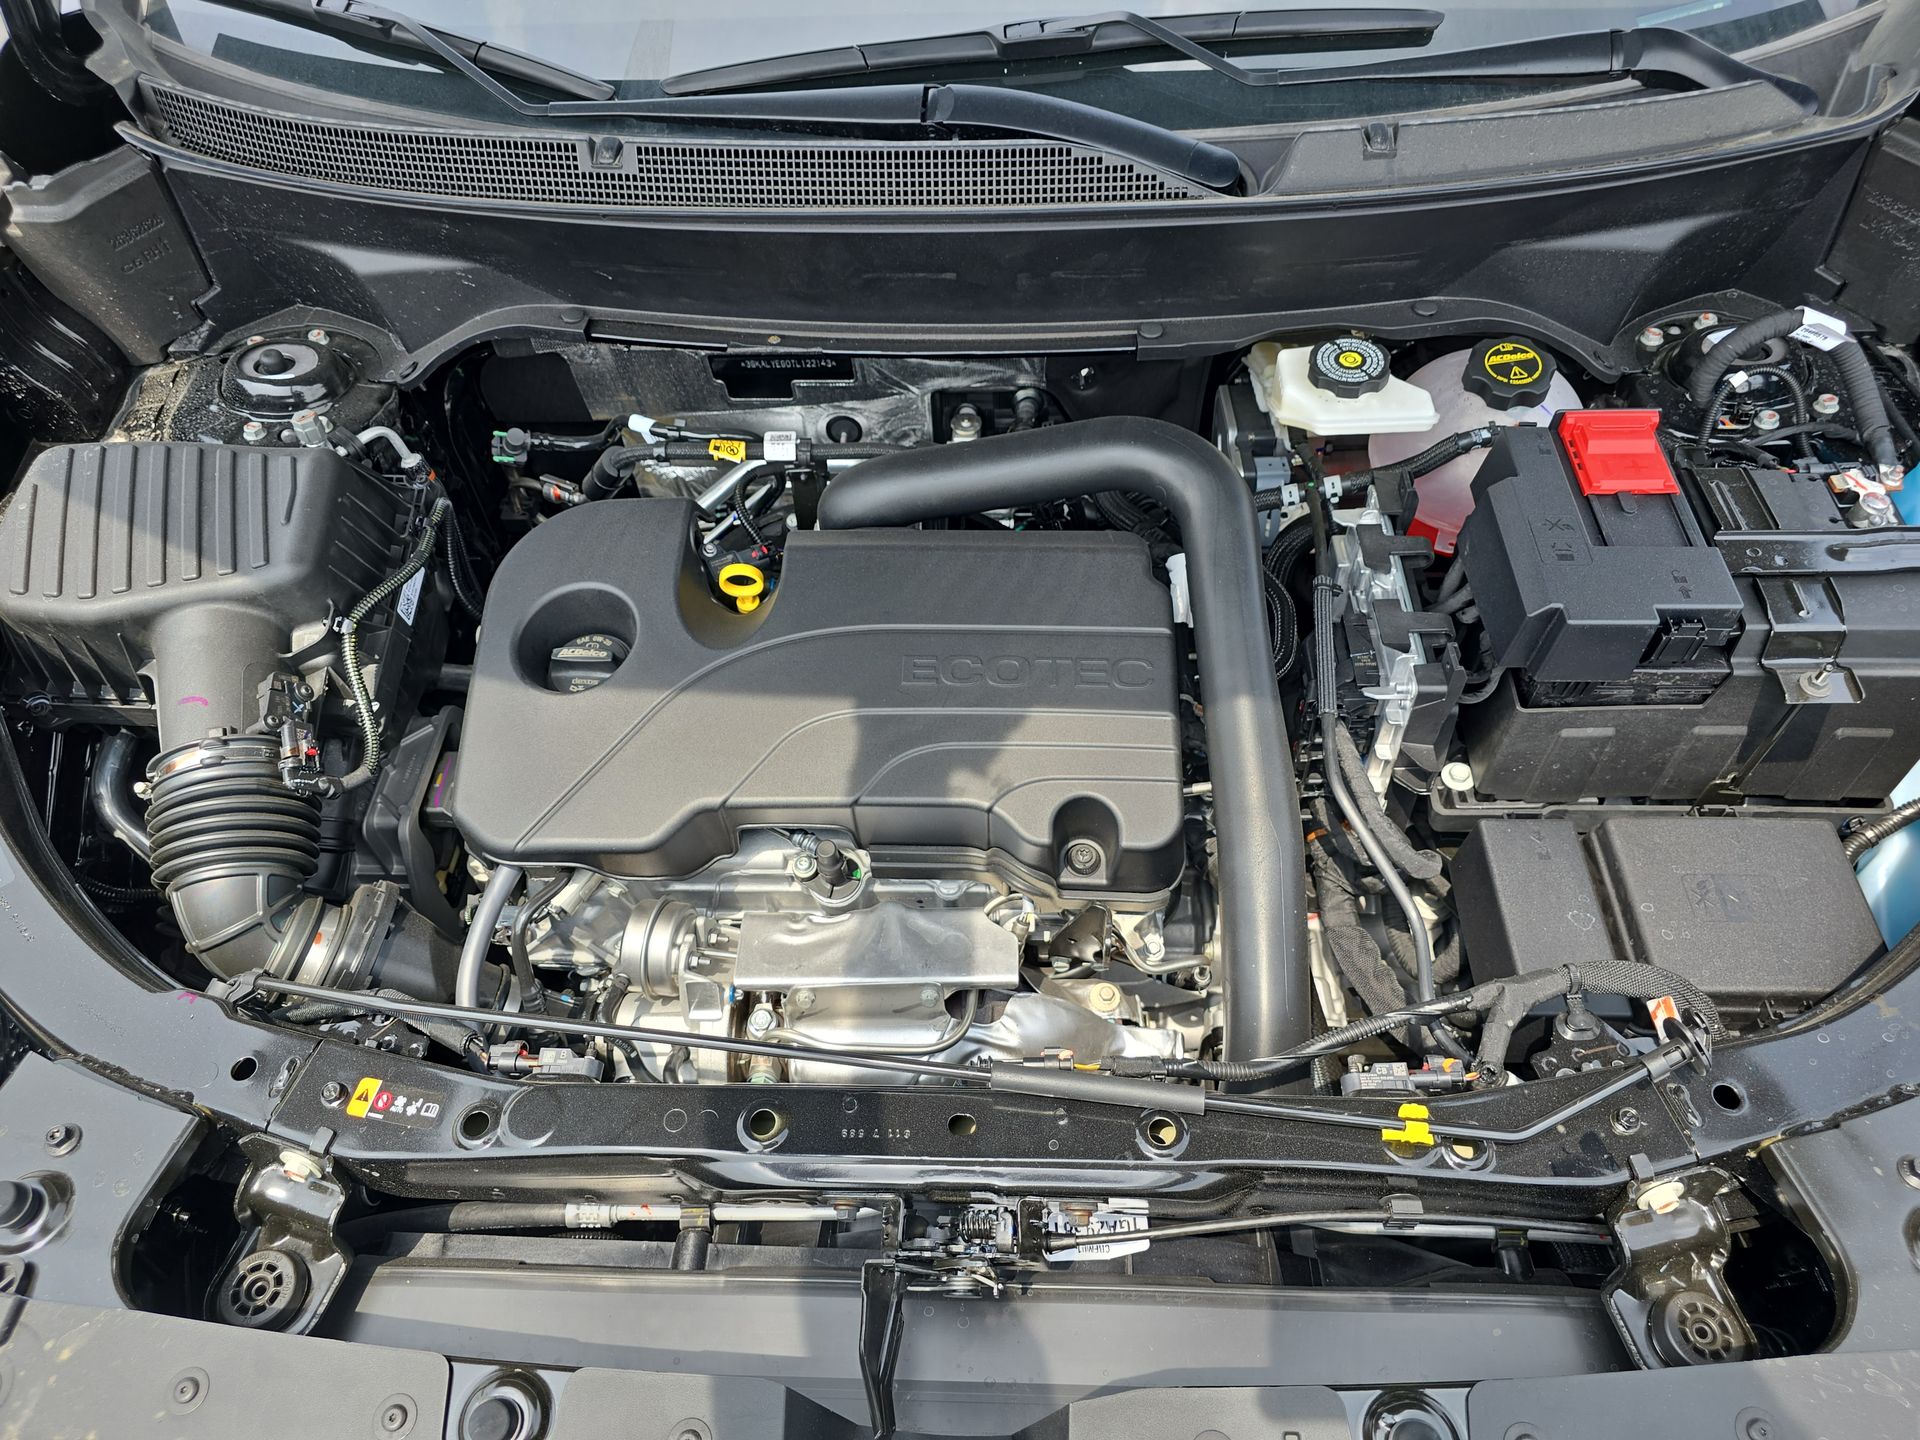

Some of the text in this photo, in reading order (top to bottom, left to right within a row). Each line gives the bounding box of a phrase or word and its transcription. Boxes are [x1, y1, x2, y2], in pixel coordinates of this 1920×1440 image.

[1488, 352, 1534, 364] ACDelco
[576, 635, 590, 645] SAE
[557, 648, 608, 658] ACDelco
[900, 654, 1155, 690] ECOTEC
[559, 1050, 567, 1059] B
[1375, 1067, 1388, 1075] CB
[389, 1104, 404, 1114] AUTO
